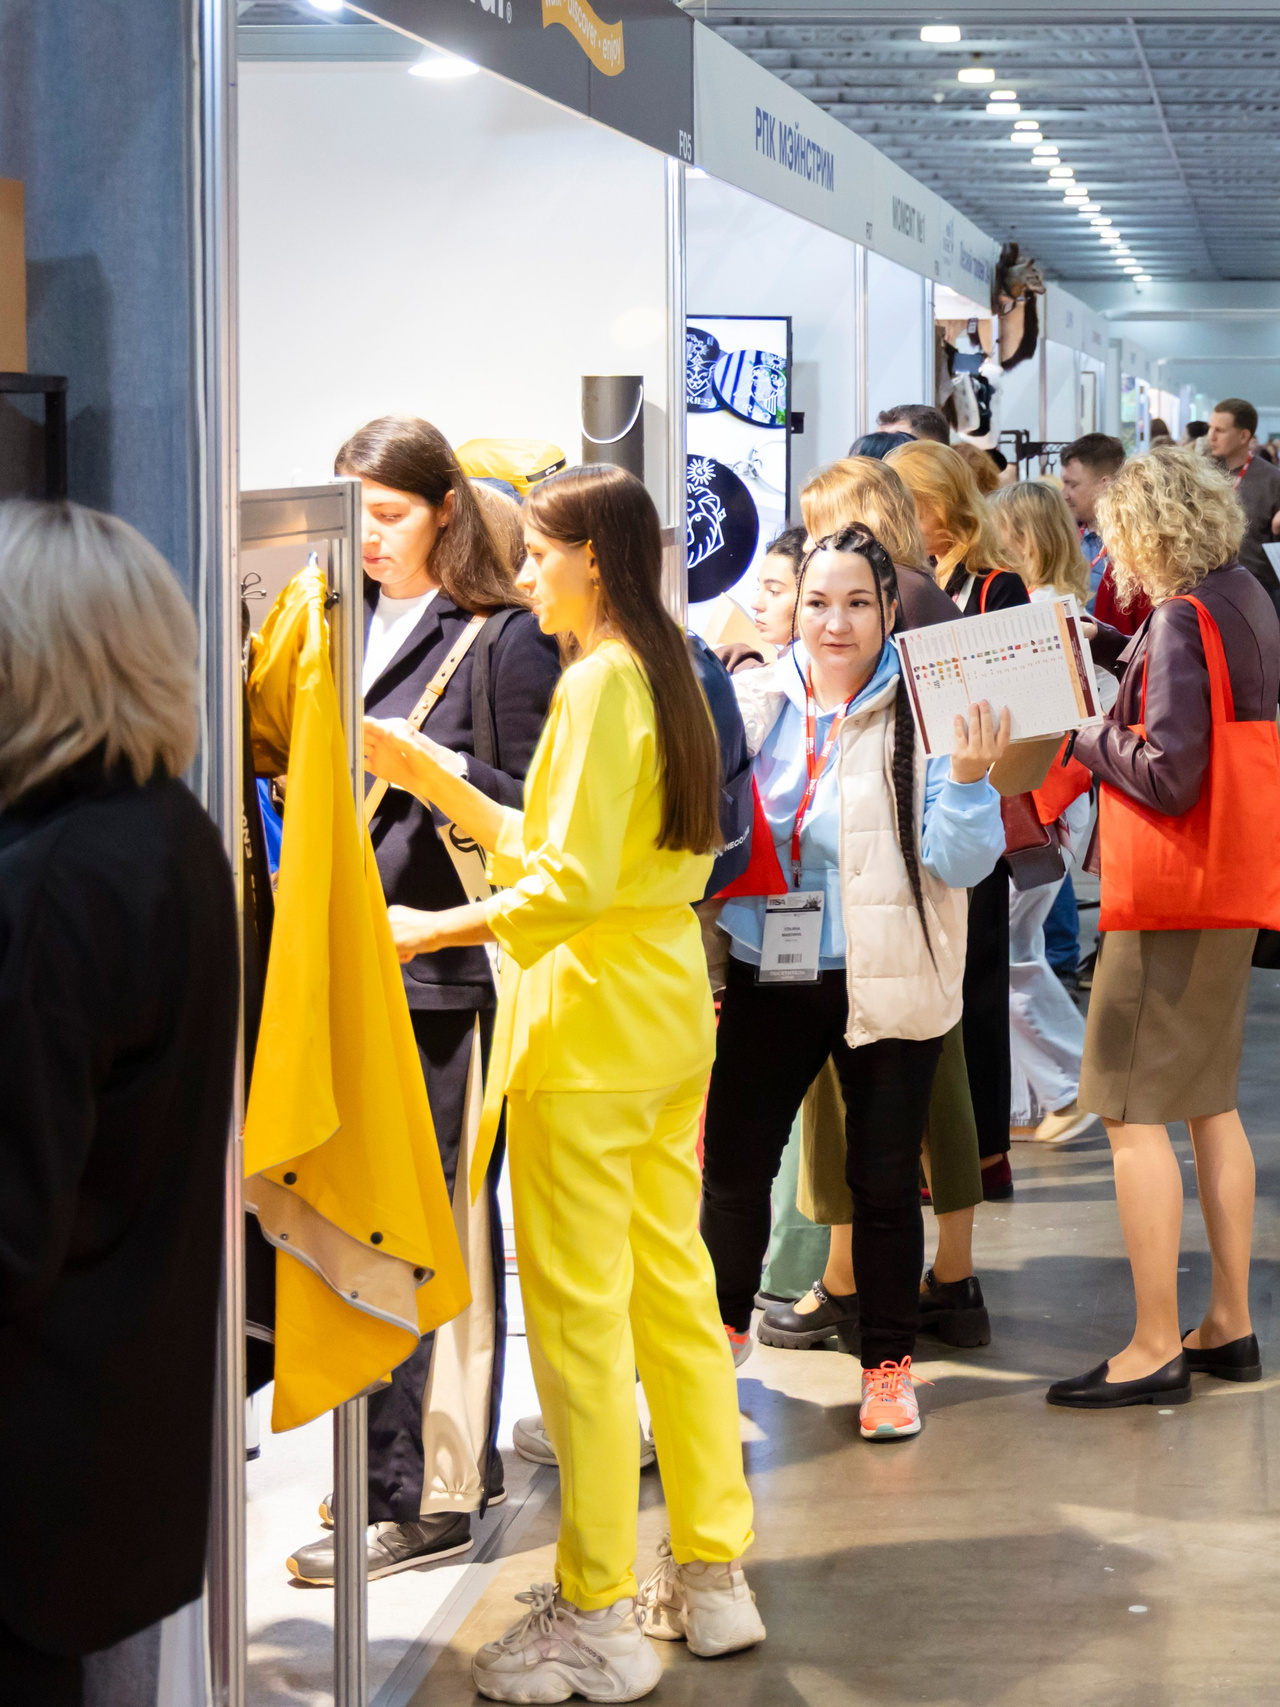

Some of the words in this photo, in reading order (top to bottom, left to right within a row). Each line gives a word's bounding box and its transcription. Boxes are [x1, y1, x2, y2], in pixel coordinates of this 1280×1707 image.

[602, 33, 621, 67] enjoy
[679, 130, 692, 161] F05
[756, 106, 776, 161] РПК
[779, 121, 834, 193] МЭЙНСТРИМ
